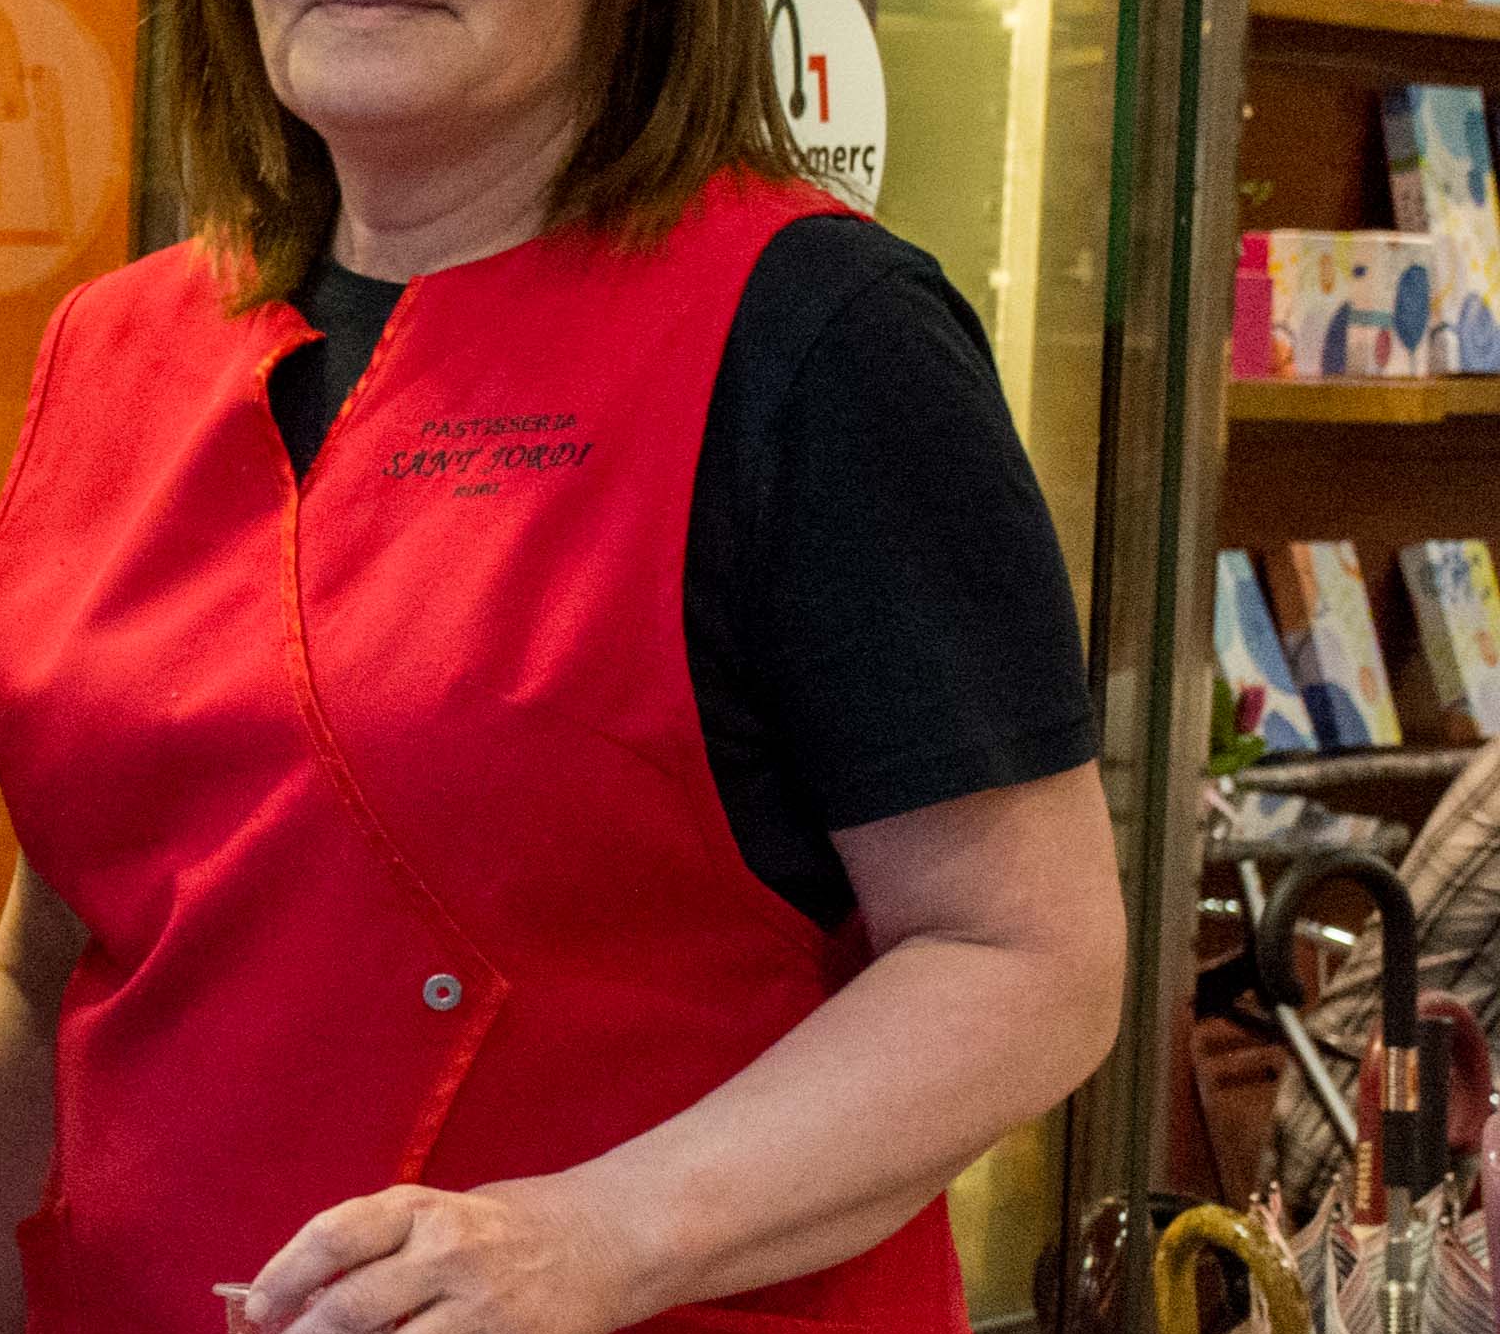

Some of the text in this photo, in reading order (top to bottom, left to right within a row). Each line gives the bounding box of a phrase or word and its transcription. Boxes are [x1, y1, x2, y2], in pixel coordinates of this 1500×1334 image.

[806, 145, 876, 185] merç
[419, 412, 578, 439] PASTISSERIA
[381, 440, 596, 480] SANT JORDI
